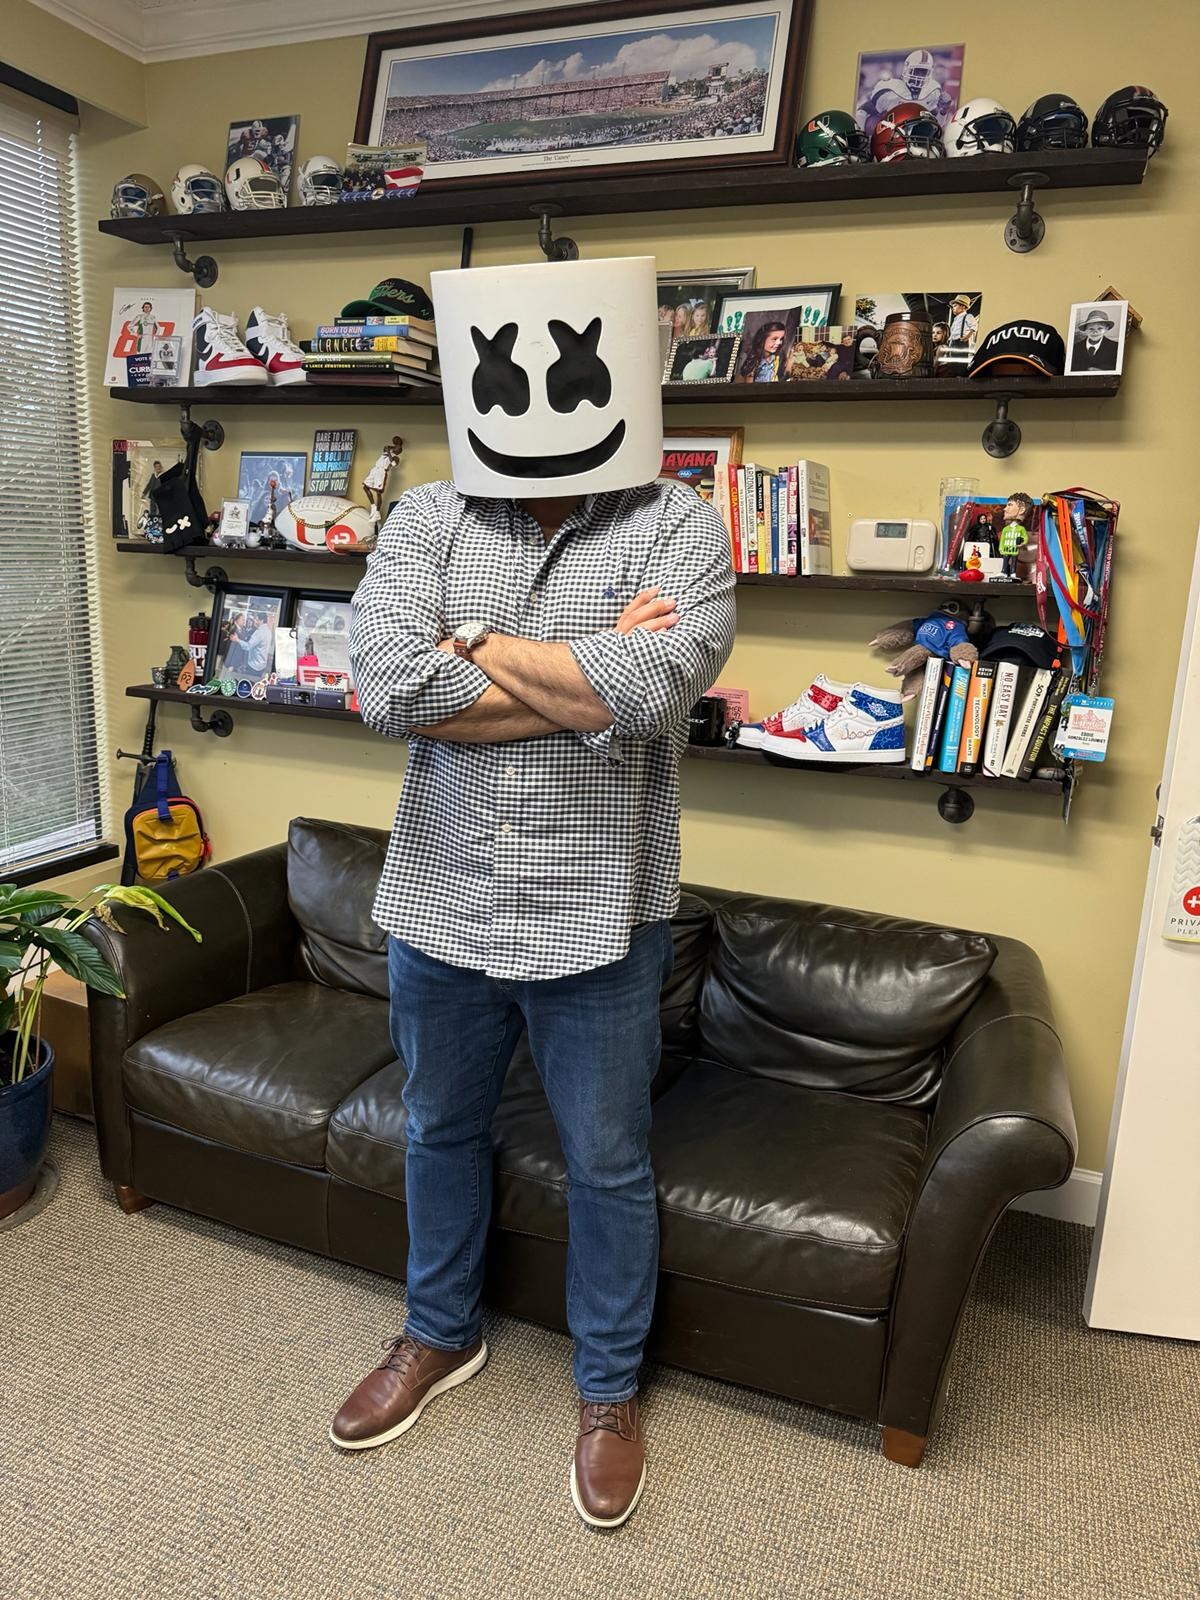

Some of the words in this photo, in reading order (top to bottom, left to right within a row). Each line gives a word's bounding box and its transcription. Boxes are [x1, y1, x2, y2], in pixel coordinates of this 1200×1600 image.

[320, 325, 339, 334] BORN
[340, 325, 348, 334] TO
[348, 325, 363, 334] RUN
[318, 338, 356, 353] LANCE
[316, 432, 331, 442] DARE
[332, 432, 341, 441] TO
[341, 432, 355, 441] LIVE
[315, 442, 330, 451] YOUR
[330, 442, 354, 451] DREAMS
[313, 452, 323, 461] BE
[324, 452, 342, 461] BOLD
[662, 452, 716, 466] AVANA
[312, 462, 328, 471] YOUR
[310, 479, 329, 492] STOP
[746, 466, 754, 494] ARIZONA
[1004, 672, 1014, 683] NO
[1001, 684, 1012, 702] EASY
[998, 704, 1009, 719] DAY
[1025, 697, 1039, 724] PORTUGUESE
[1047, 704, 1058, 715] THE
[1020, 724, 1029, 738] VERBS
[1039, 714, 1053, 736] IMPACT
[1028, 735, 1046, 763] EQUATION
